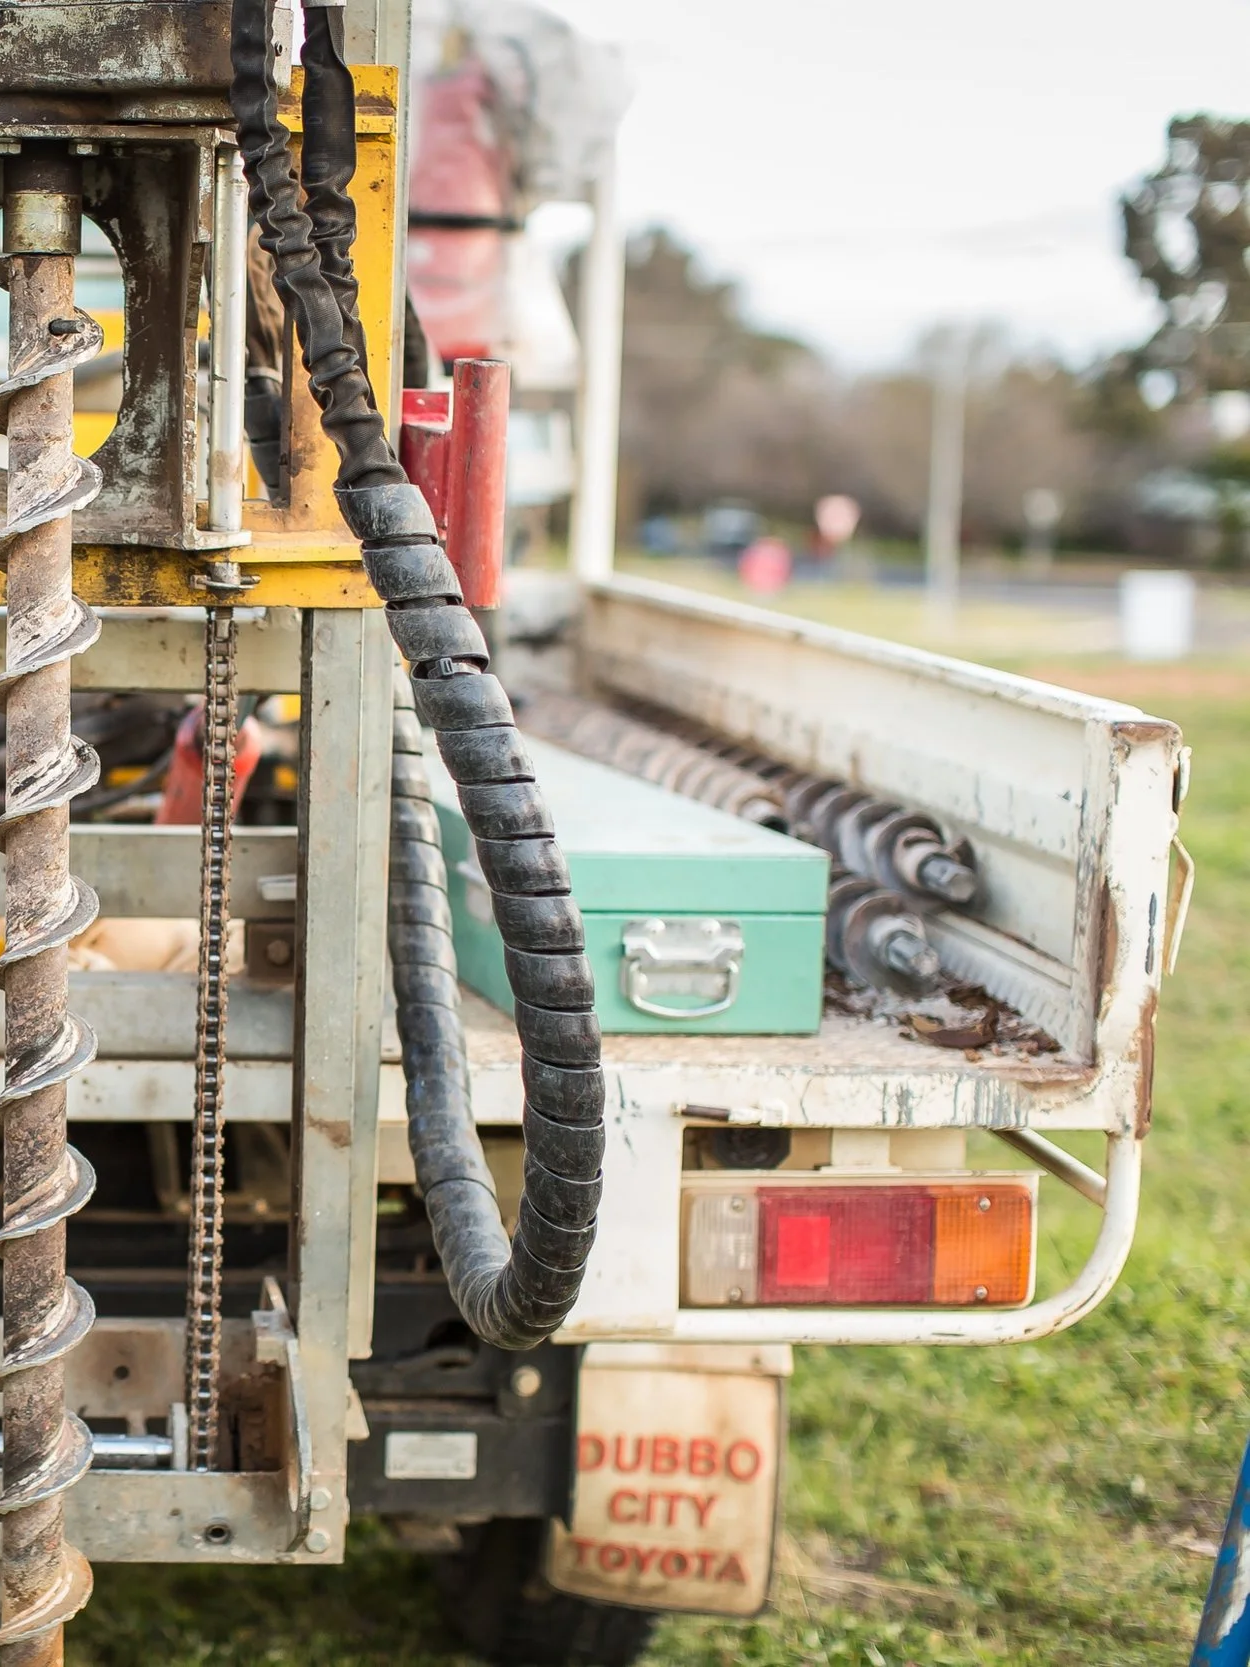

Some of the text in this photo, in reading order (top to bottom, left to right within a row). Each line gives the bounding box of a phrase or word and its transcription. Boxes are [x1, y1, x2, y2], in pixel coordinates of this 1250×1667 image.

[577, 1433, 761, 1482] DUBBO
[609, 1490, 718, 1528] CITY
[571, 1537, 746, 1584] TOYOTA
